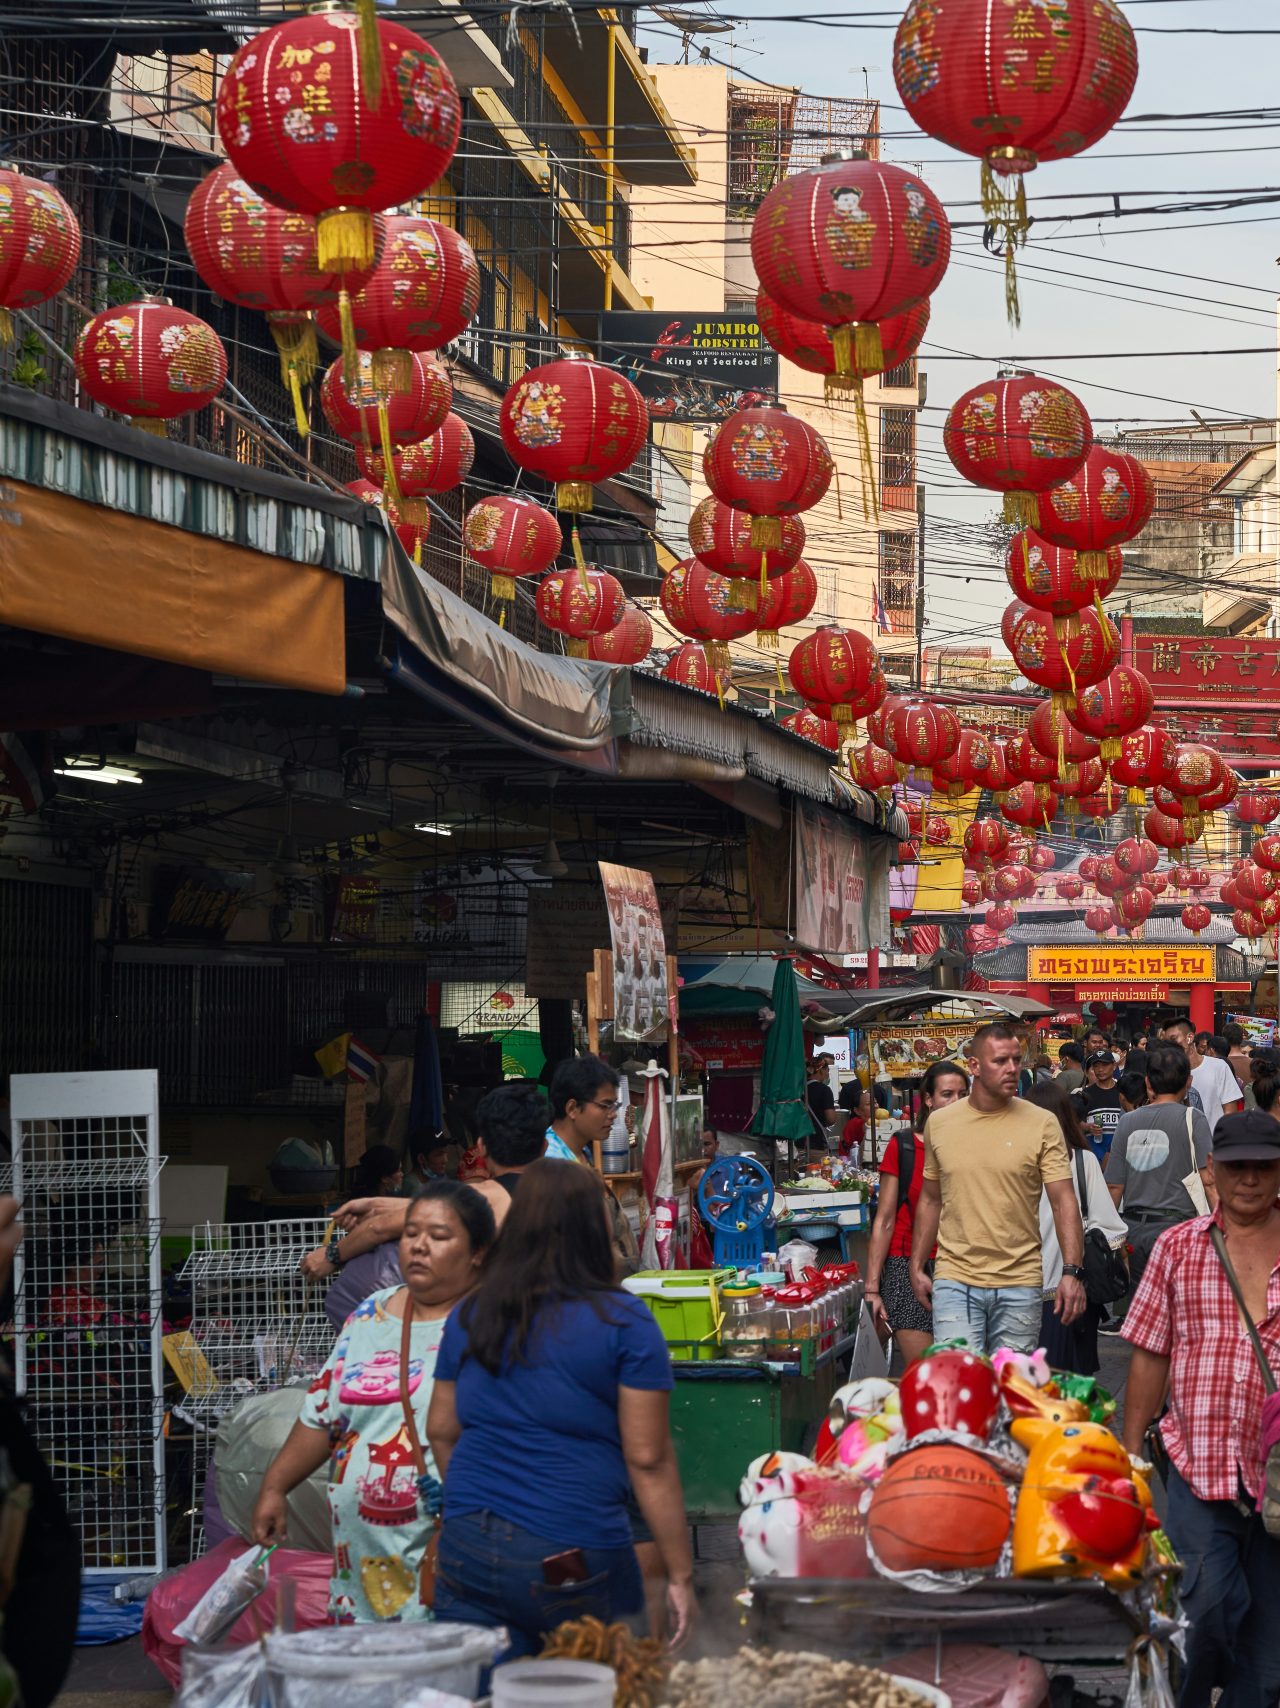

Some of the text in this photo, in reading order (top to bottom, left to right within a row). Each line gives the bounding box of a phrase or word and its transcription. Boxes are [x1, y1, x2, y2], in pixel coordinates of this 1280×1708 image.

[692, 323, 760, 335] JUMBO
[693, 338, 759, 349] LOBSTER
[666, 357, 758, 367] King of Seafood
[1038, 951, 1206, 975] ทรงพระเจริญ
